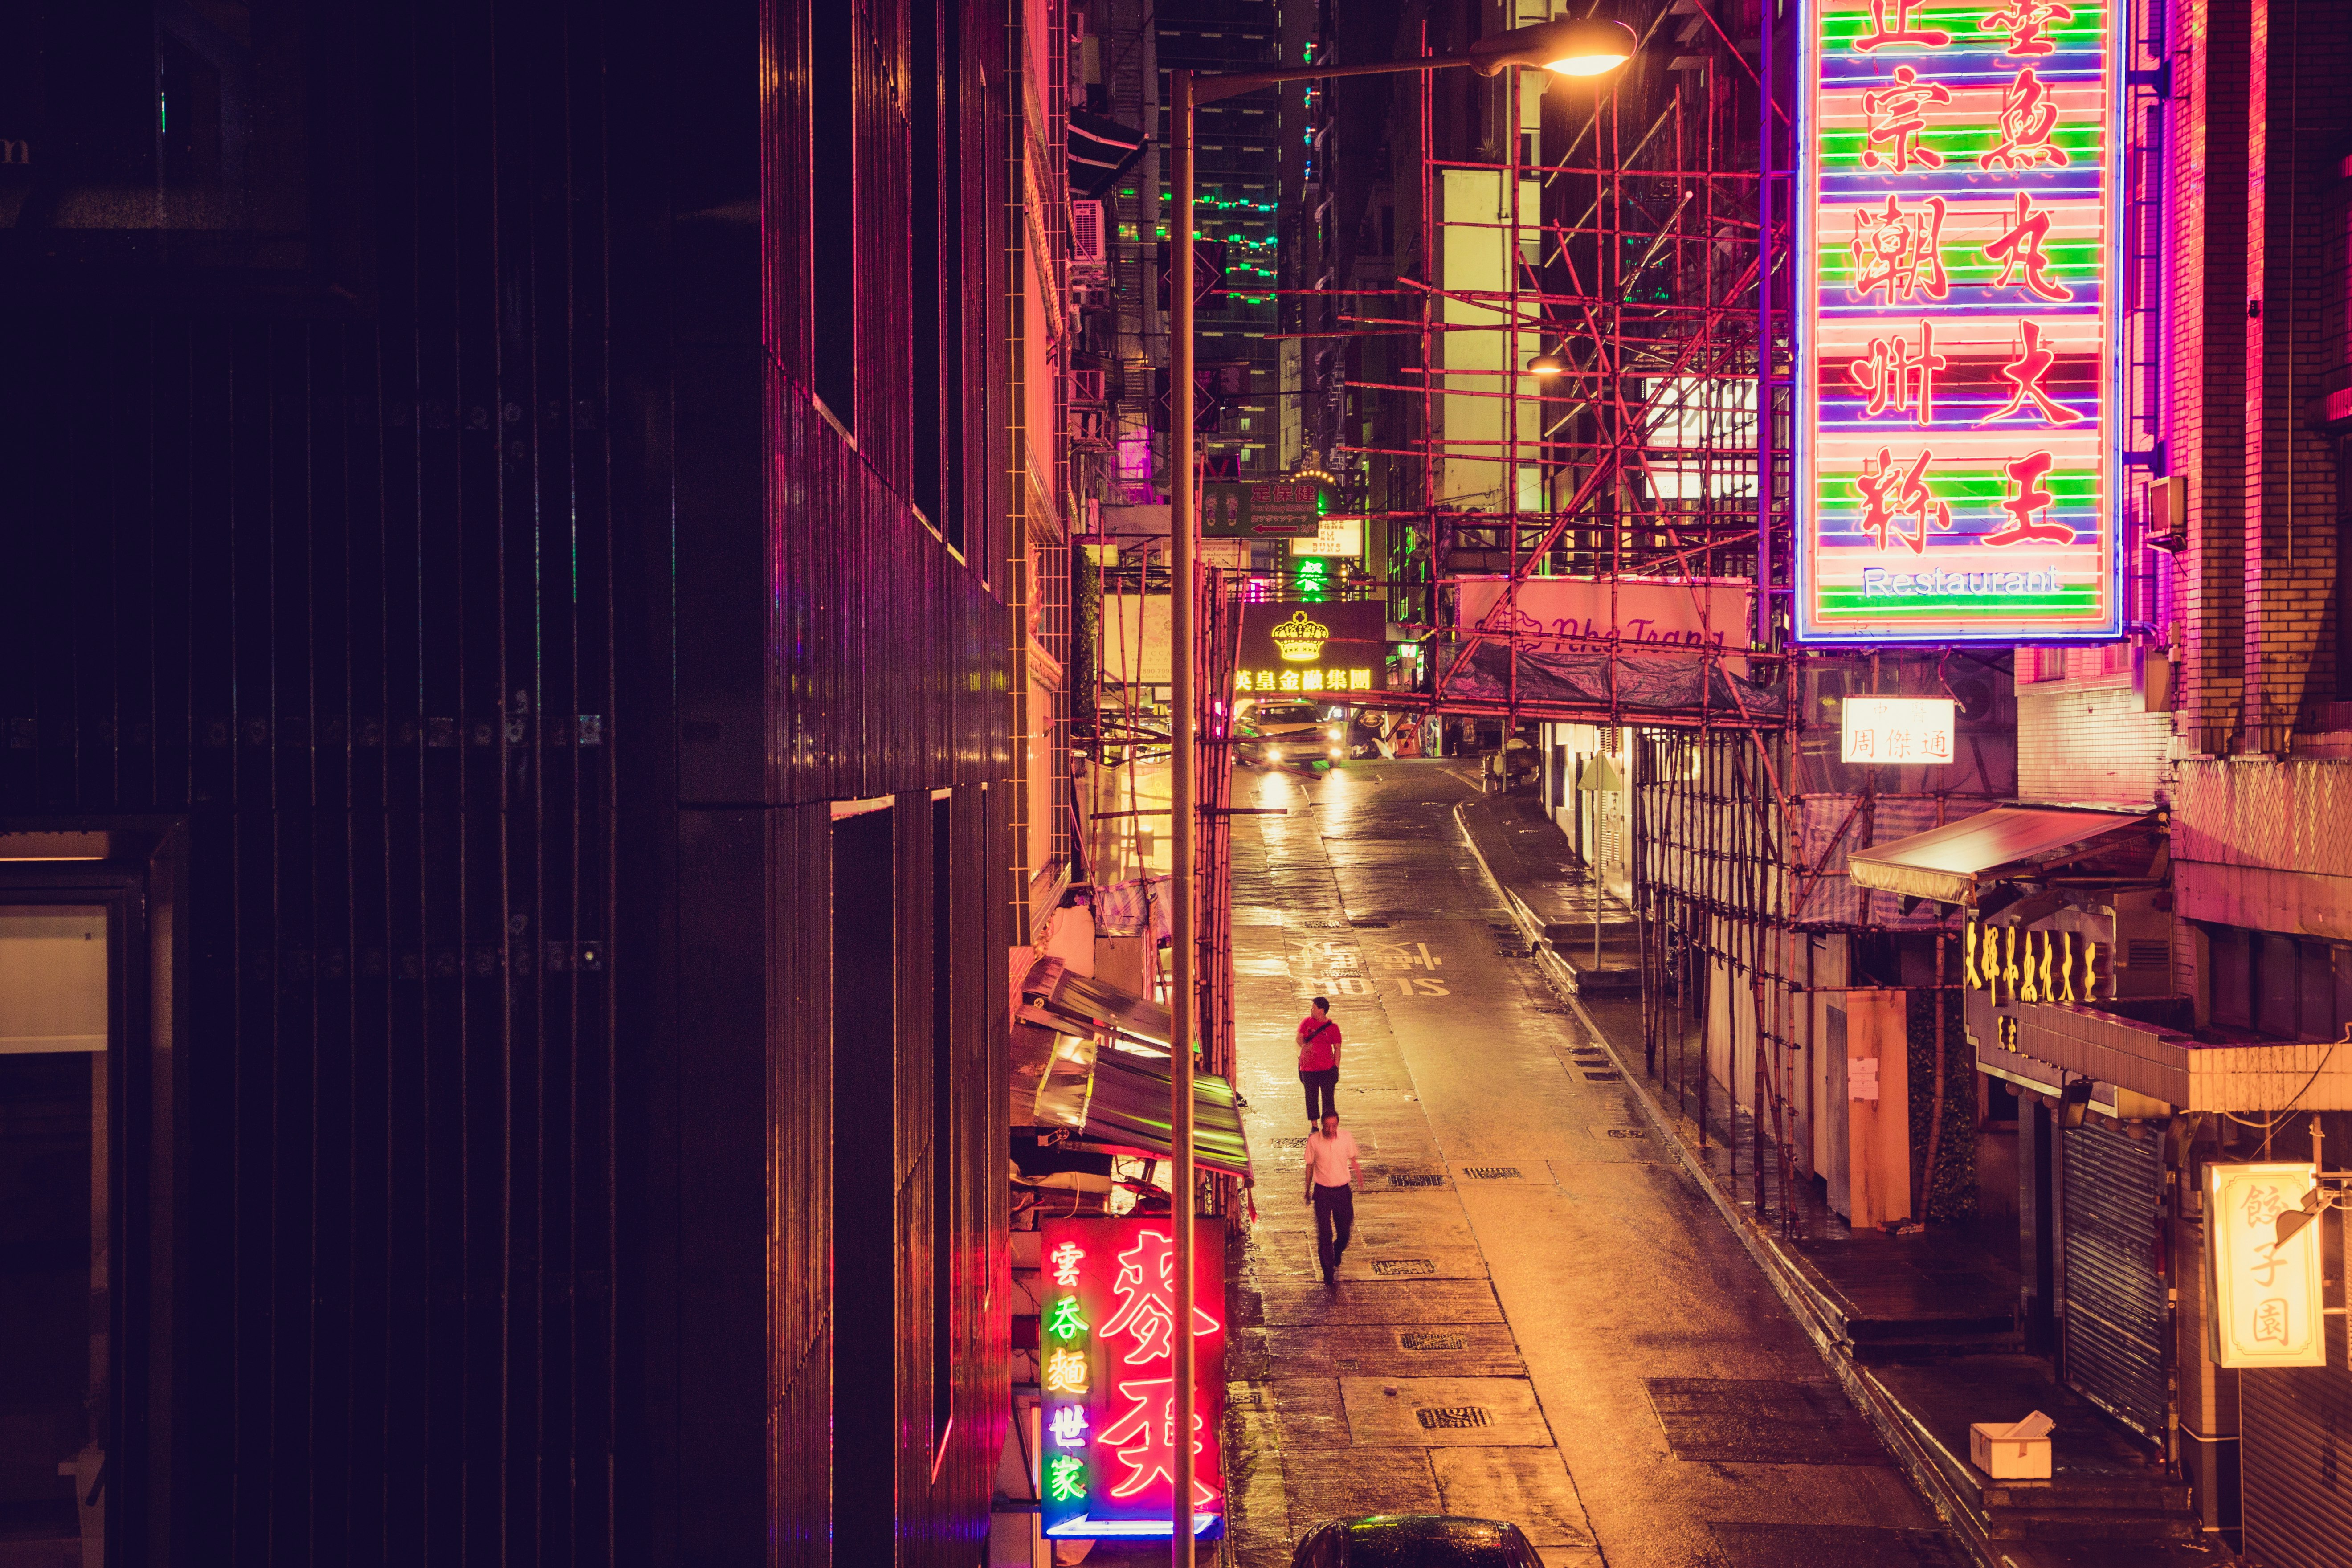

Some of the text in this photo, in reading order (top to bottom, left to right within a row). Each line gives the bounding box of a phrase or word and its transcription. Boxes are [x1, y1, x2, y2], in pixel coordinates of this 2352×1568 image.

[1251, 485, 1316, 502] 足保健
[1320, 531, 1335, 541] EM
[1312, 543, 1341, 553] BUNS
[1862, 564, 2063, 598] Restaurant
[1235, 668, 1371, 690] 英皇金融集團
[1874, 702, 1927, 723] 中醫
[1850, 728, 1949, 759] 周傑通
[1302, 976, 1450, 997] SLOW
[2241, 1184, 2289, 1347] 餃子園
